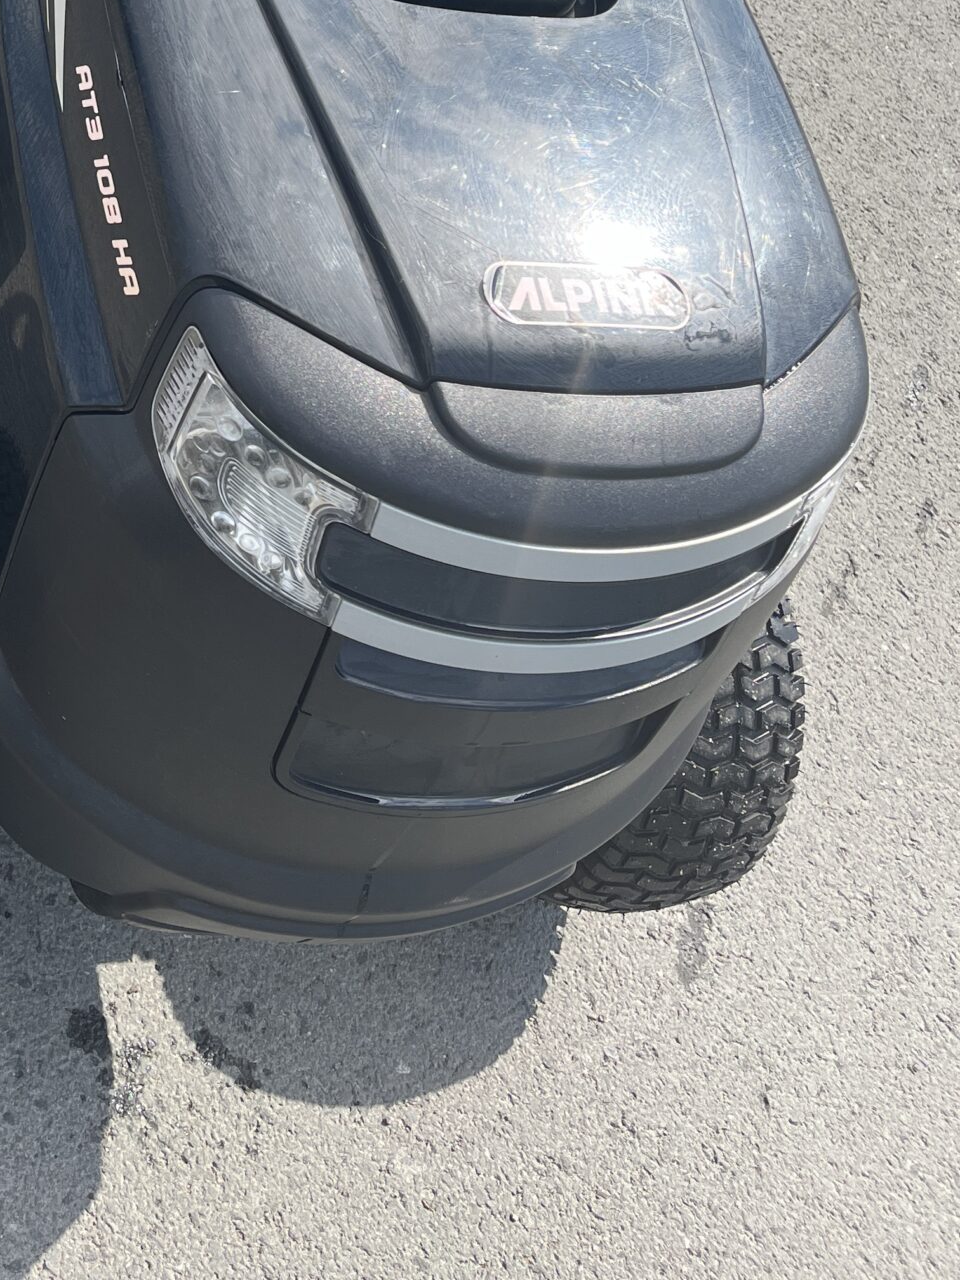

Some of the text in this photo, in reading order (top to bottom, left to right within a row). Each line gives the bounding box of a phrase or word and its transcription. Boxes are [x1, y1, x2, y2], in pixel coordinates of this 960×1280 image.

[75, 64, 140, 296] AT3 108 HA
